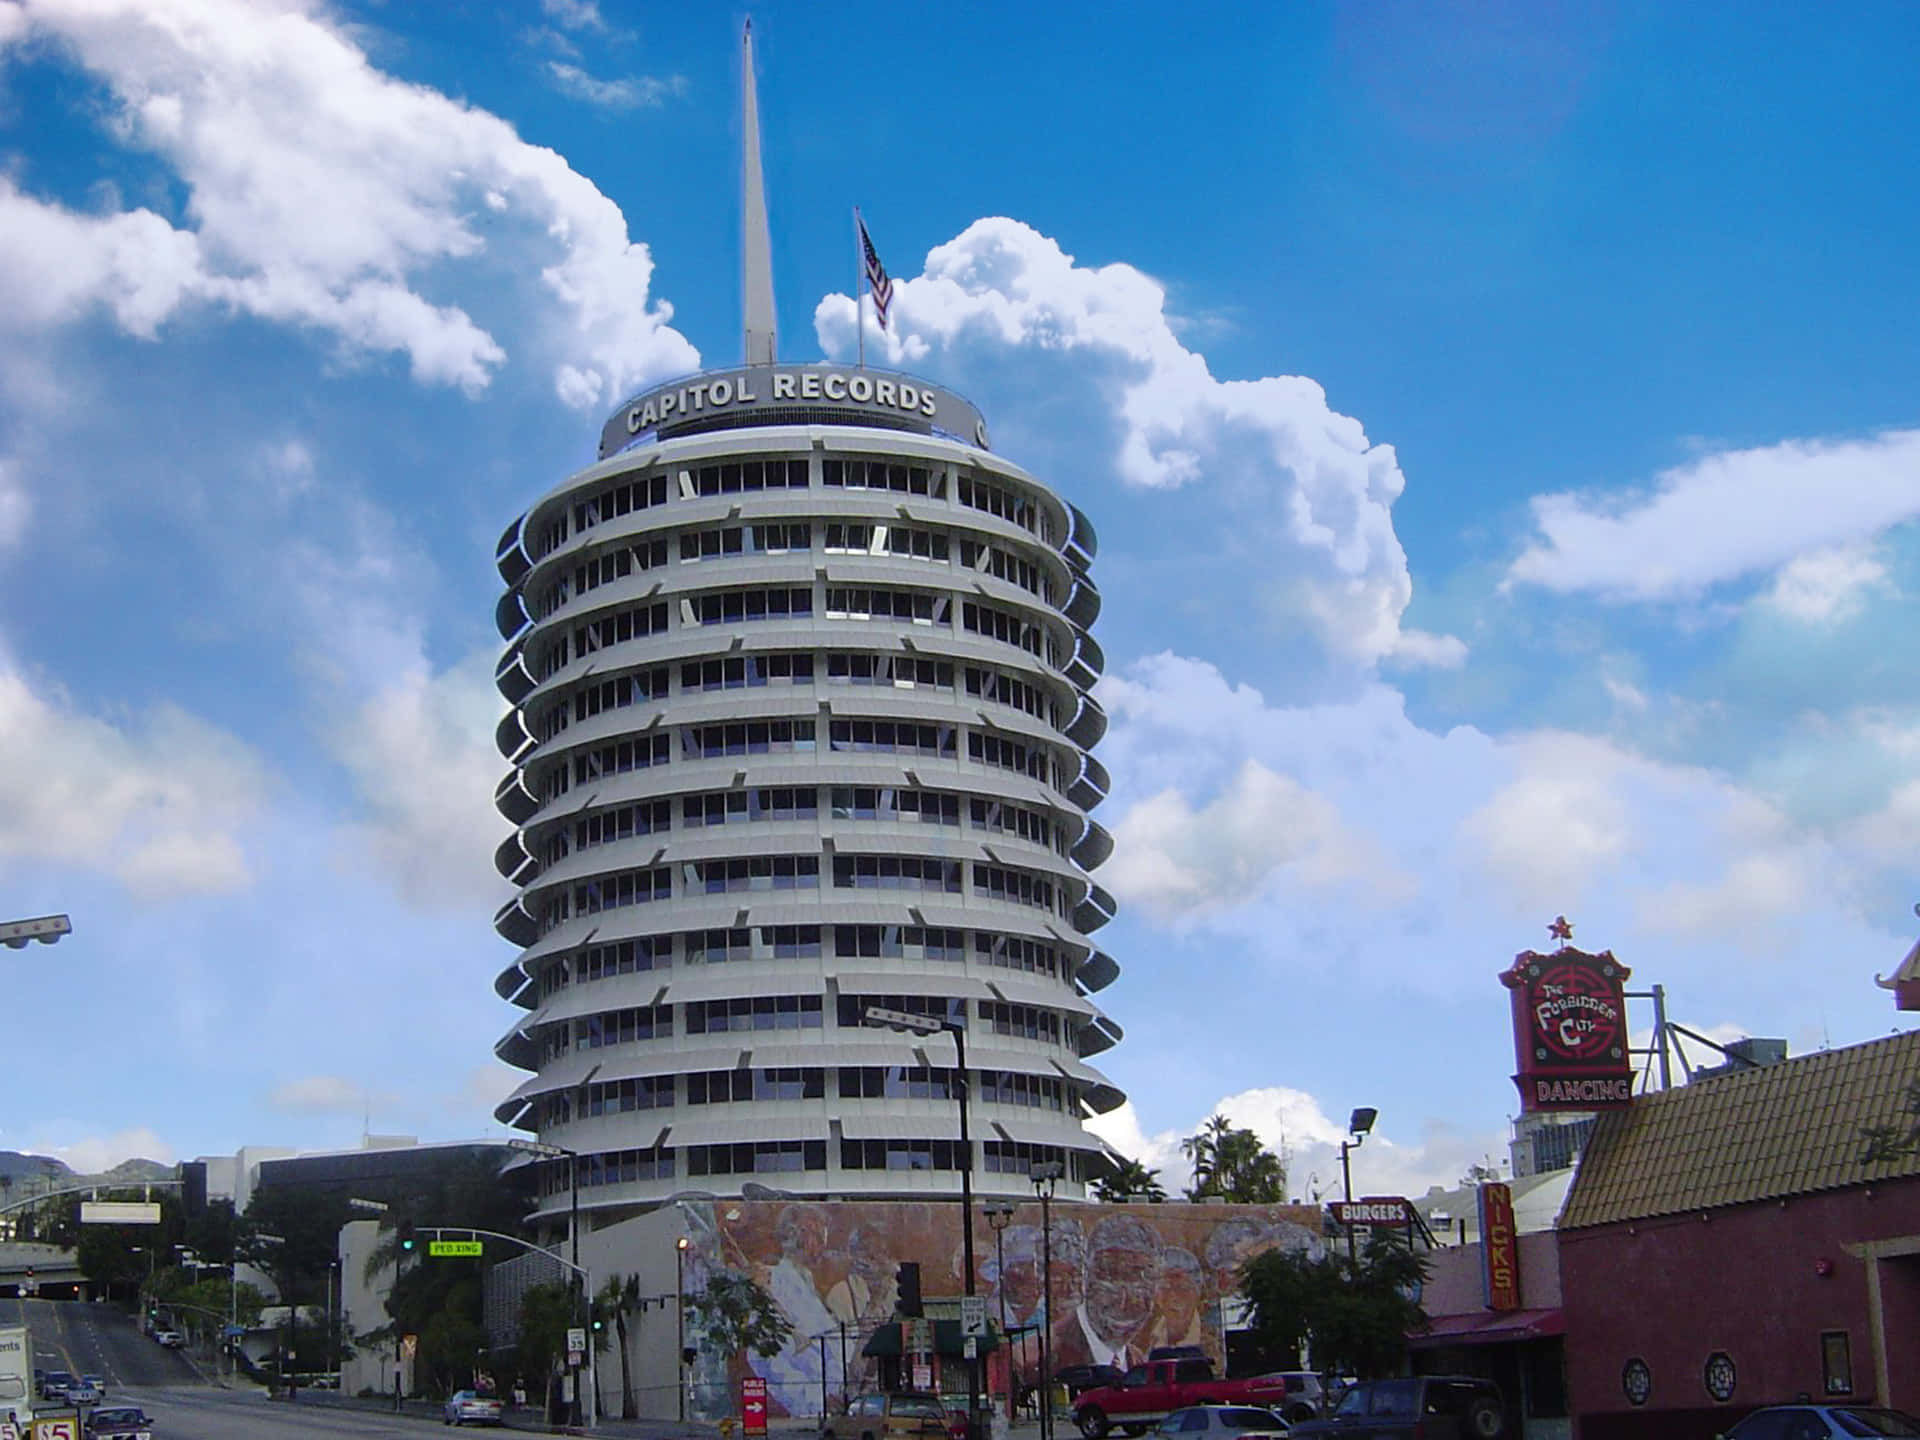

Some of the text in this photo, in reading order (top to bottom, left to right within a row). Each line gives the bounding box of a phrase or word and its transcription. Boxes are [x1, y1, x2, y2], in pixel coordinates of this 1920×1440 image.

[626, 373, 937, 434] CAPITOL RECORDS
[1537, 1080, 1629, 1102] DANCING
[1341, 1204, 1406, 1220] BURGERS
[456, 1243, 478, 1254] XING
